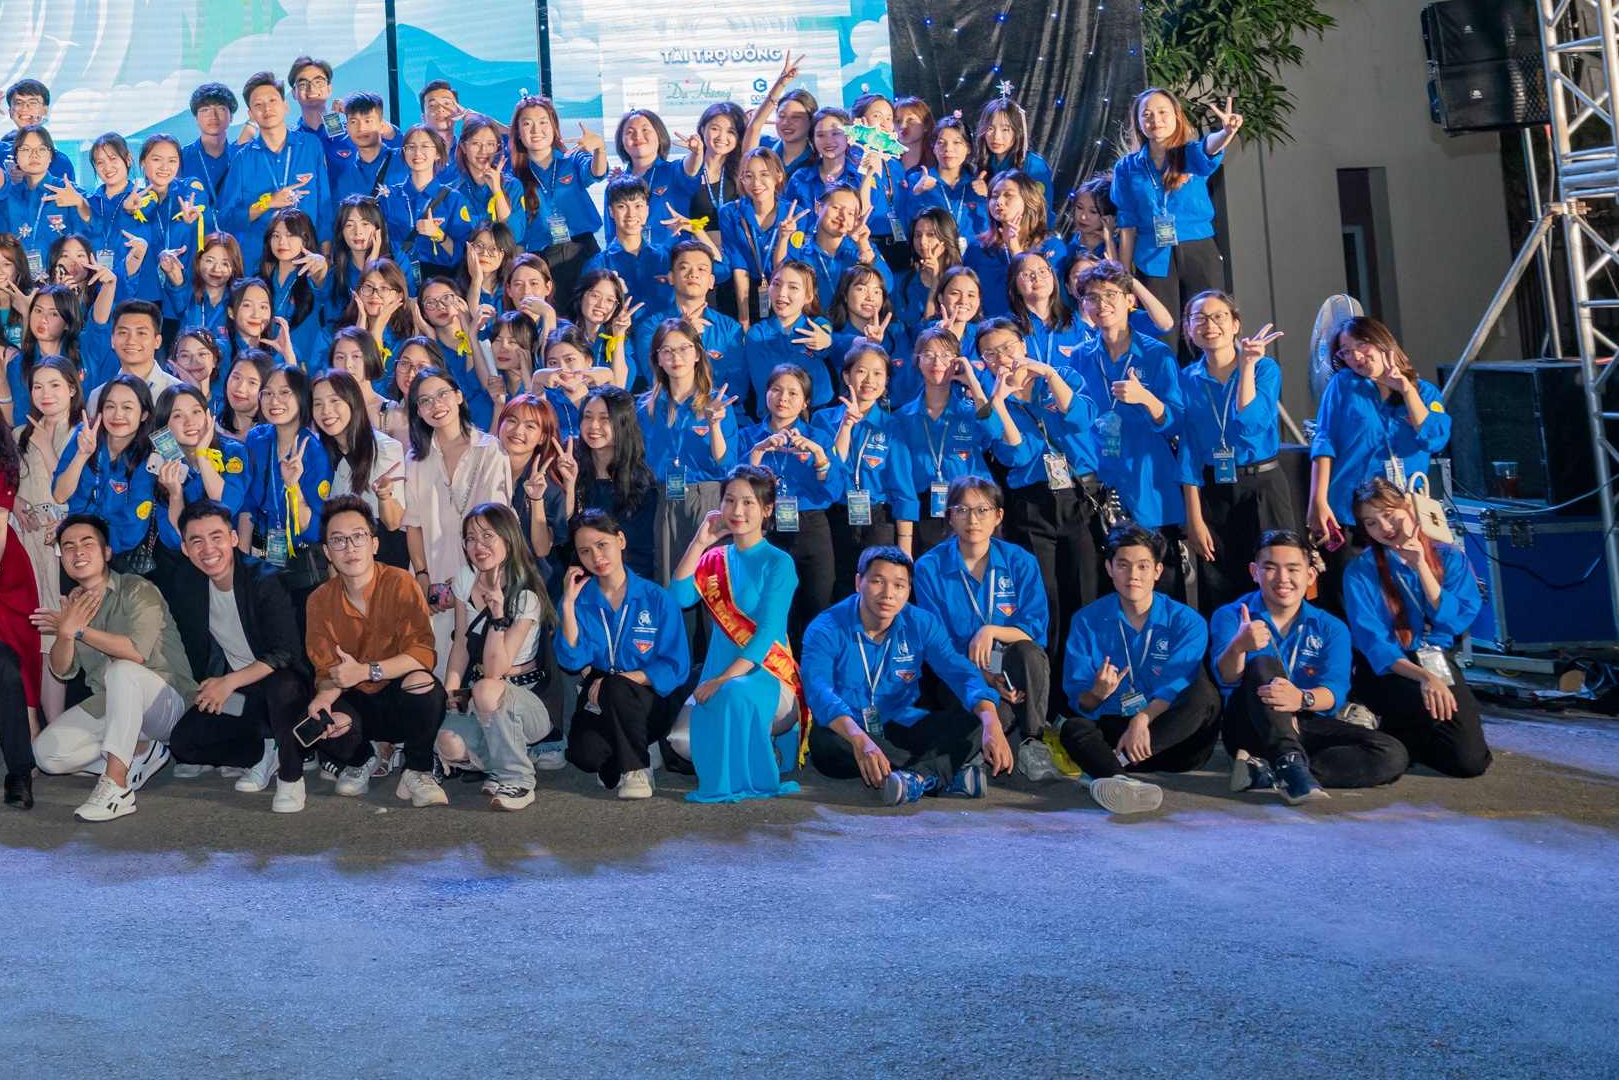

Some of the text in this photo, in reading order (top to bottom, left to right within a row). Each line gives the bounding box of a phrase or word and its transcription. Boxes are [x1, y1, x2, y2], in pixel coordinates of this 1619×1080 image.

[661, 43, 782, 66] TÀI TRỢ ĐỒNG
